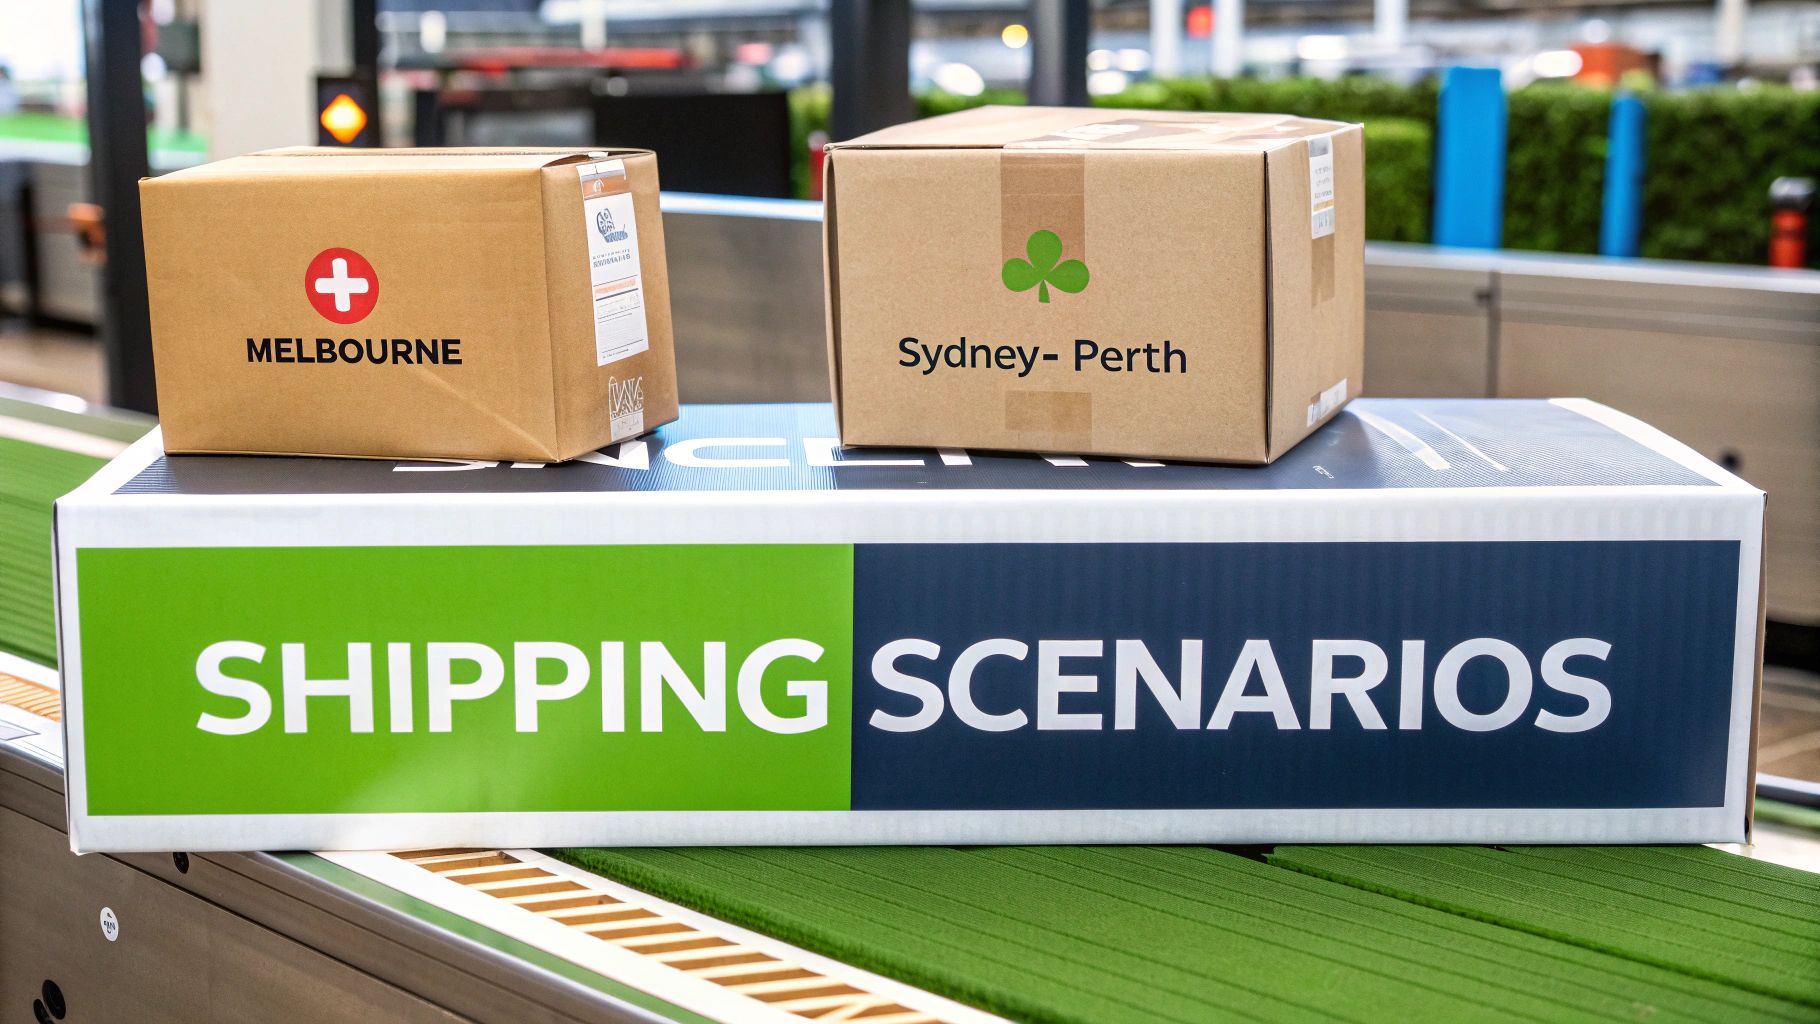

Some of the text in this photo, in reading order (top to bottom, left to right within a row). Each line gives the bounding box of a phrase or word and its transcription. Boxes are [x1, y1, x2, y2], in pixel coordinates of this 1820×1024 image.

[246, 336, 462, 366] MELBOURNE
[898, 335, 1188, 378] Sydney- Perth
[194, 637, 1612, 736] SHIPPING SCENARIOS
